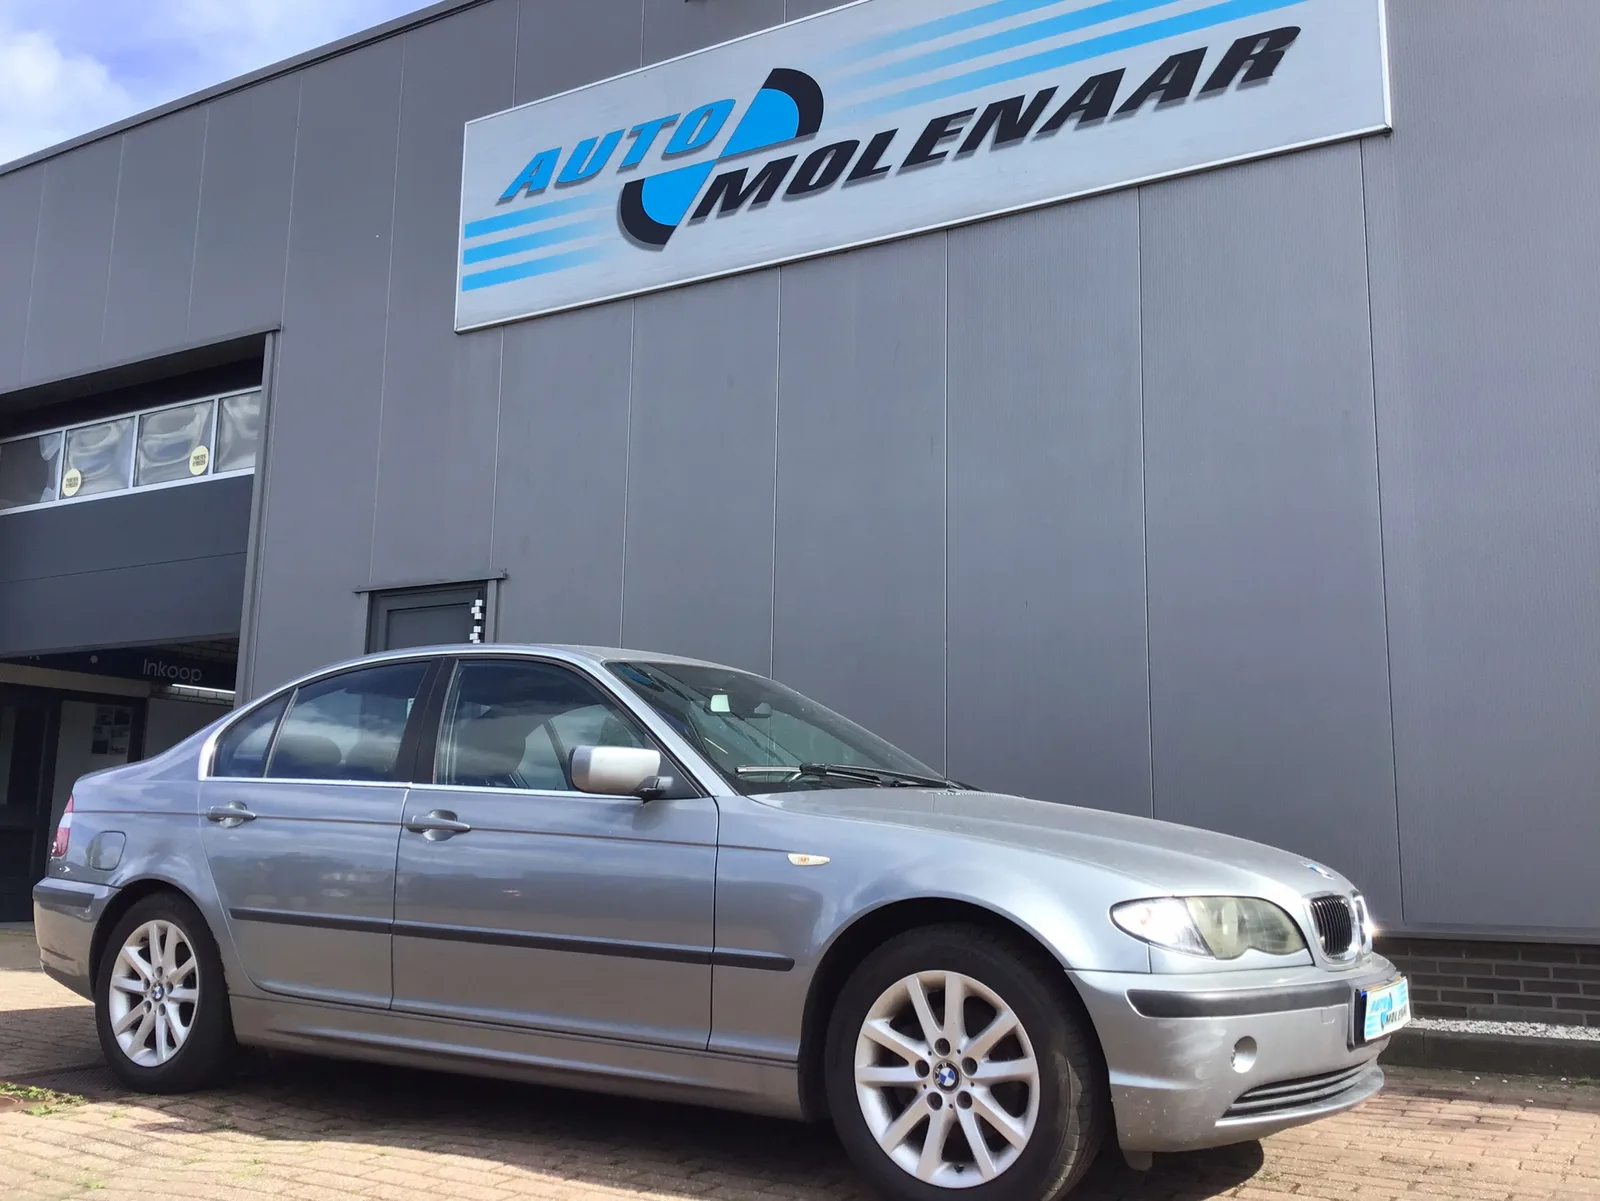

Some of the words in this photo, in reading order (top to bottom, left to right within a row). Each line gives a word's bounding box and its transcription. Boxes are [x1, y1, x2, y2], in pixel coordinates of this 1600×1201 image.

[498, 98, 737, 203] AUTO
[689, 25, 1303, 223] MOLENAAR
[142, 658, 202, 684] Inkoop
